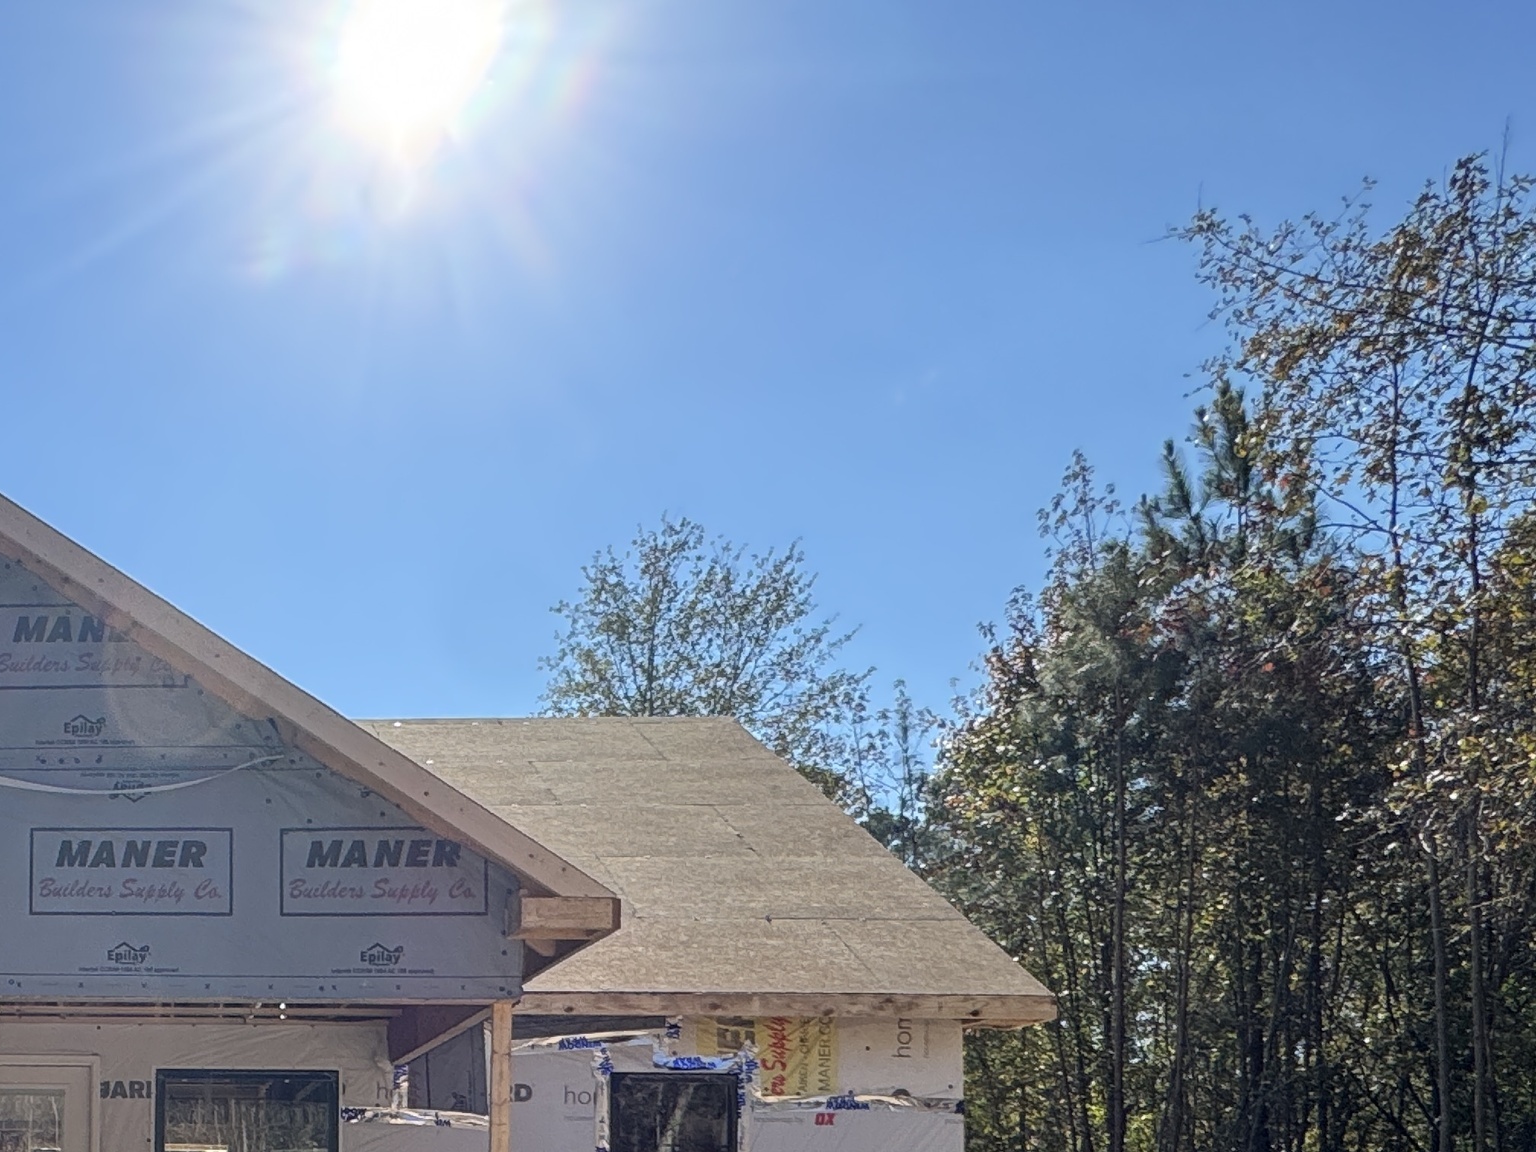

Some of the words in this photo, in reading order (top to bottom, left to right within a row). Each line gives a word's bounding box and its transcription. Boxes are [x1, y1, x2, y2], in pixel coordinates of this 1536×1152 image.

[13, 616, 130, 643] MAN
[64, 722, 103, 736] Epilay
[55, 839, 207, 868] MANER
[306, 839, 462, 868] MANER
[39, 877, 113, 899] Builders
[119, 877, 184, 904] Supply
[194, 878, 223, 900] Co.
[289, 878, 364, 900] Builders
[371, 878, 439, 905] Supply
[449, 878, 476, 900] Co.
[107, 949, 147, 964] Epilay
[360, 950, 401, 966] Epilay
[814, 1112, 836, 1126] OX
